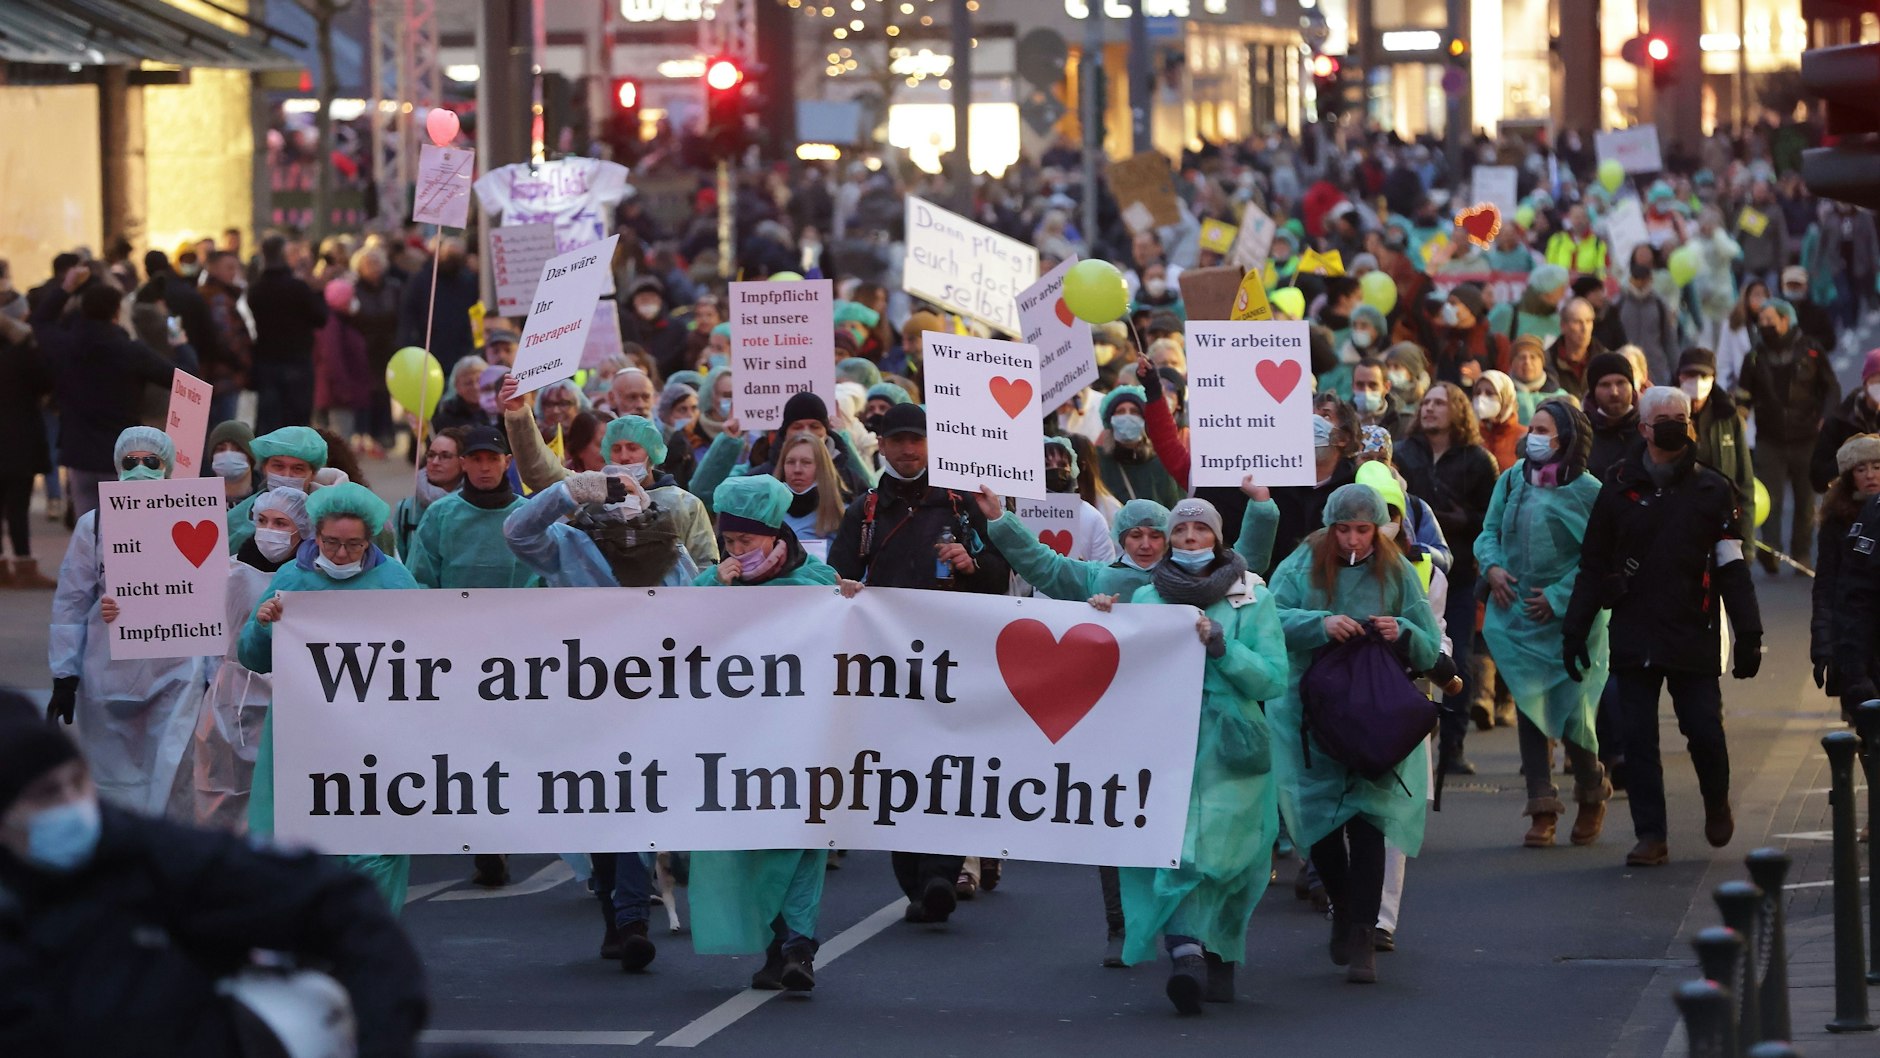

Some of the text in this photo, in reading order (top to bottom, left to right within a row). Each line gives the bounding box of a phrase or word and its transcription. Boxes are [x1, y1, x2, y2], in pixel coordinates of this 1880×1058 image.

[916, 205, 965, 242] Dann
[545, 265, 567, 282] Das
[570, 252, 598, 273] wäre
[913, 246, 1021, 298] euch doch
[741, 289, 819, 305] Impfpflicht
[941, 284, 1014, 327] selbst
[1020, 297, 1037, 313] Wir
[534, 299, 554, 315] Ihr
[741, 313, 809, 325] ist unsere
[525, 318, 583, 348] Therapeut
[742, 334, 813, 346] rote Linie:
[1027, 326, 1043, 344] mit
[1194, 333, 1302, 348] Wir arbeiten
[743, 356, 807, 370] Wir sind
[932, 343, 1033, 369] Wir arbeiten
[1040, 339, 1073, 370] cht mit
[515, 357, 563, 382] gewesen.
[744, 380, 814, 395] dann mal
[1042, 360, 1090, 402] mpfpflicht!
[1196, 374, 1226, 388] mit
[933, 383, 961, 397] mit
[745, 405, 780, 422] weg!
[1198, 414, 1276, 428] nicht mit
[936, 420, 1009, 441] nicht mit
[937, 456, 1034, 482] Impfpflicht!
[1200, 454, 1304, 471] Impfpflicht!
[109, 492, 218, 511] Wir arbeiten
[1020, 505, 1074, 519] arbeiten
[112, 539, 142, 554] mit
[115, 580, 194, 597] nicht mit
[118, 622, 223, 643] Impfpflicht!
[305, 637, 959, 703] Wir arbeiten mit
[308, 750, 1152, 829] nicht mit Impfpflicht!
